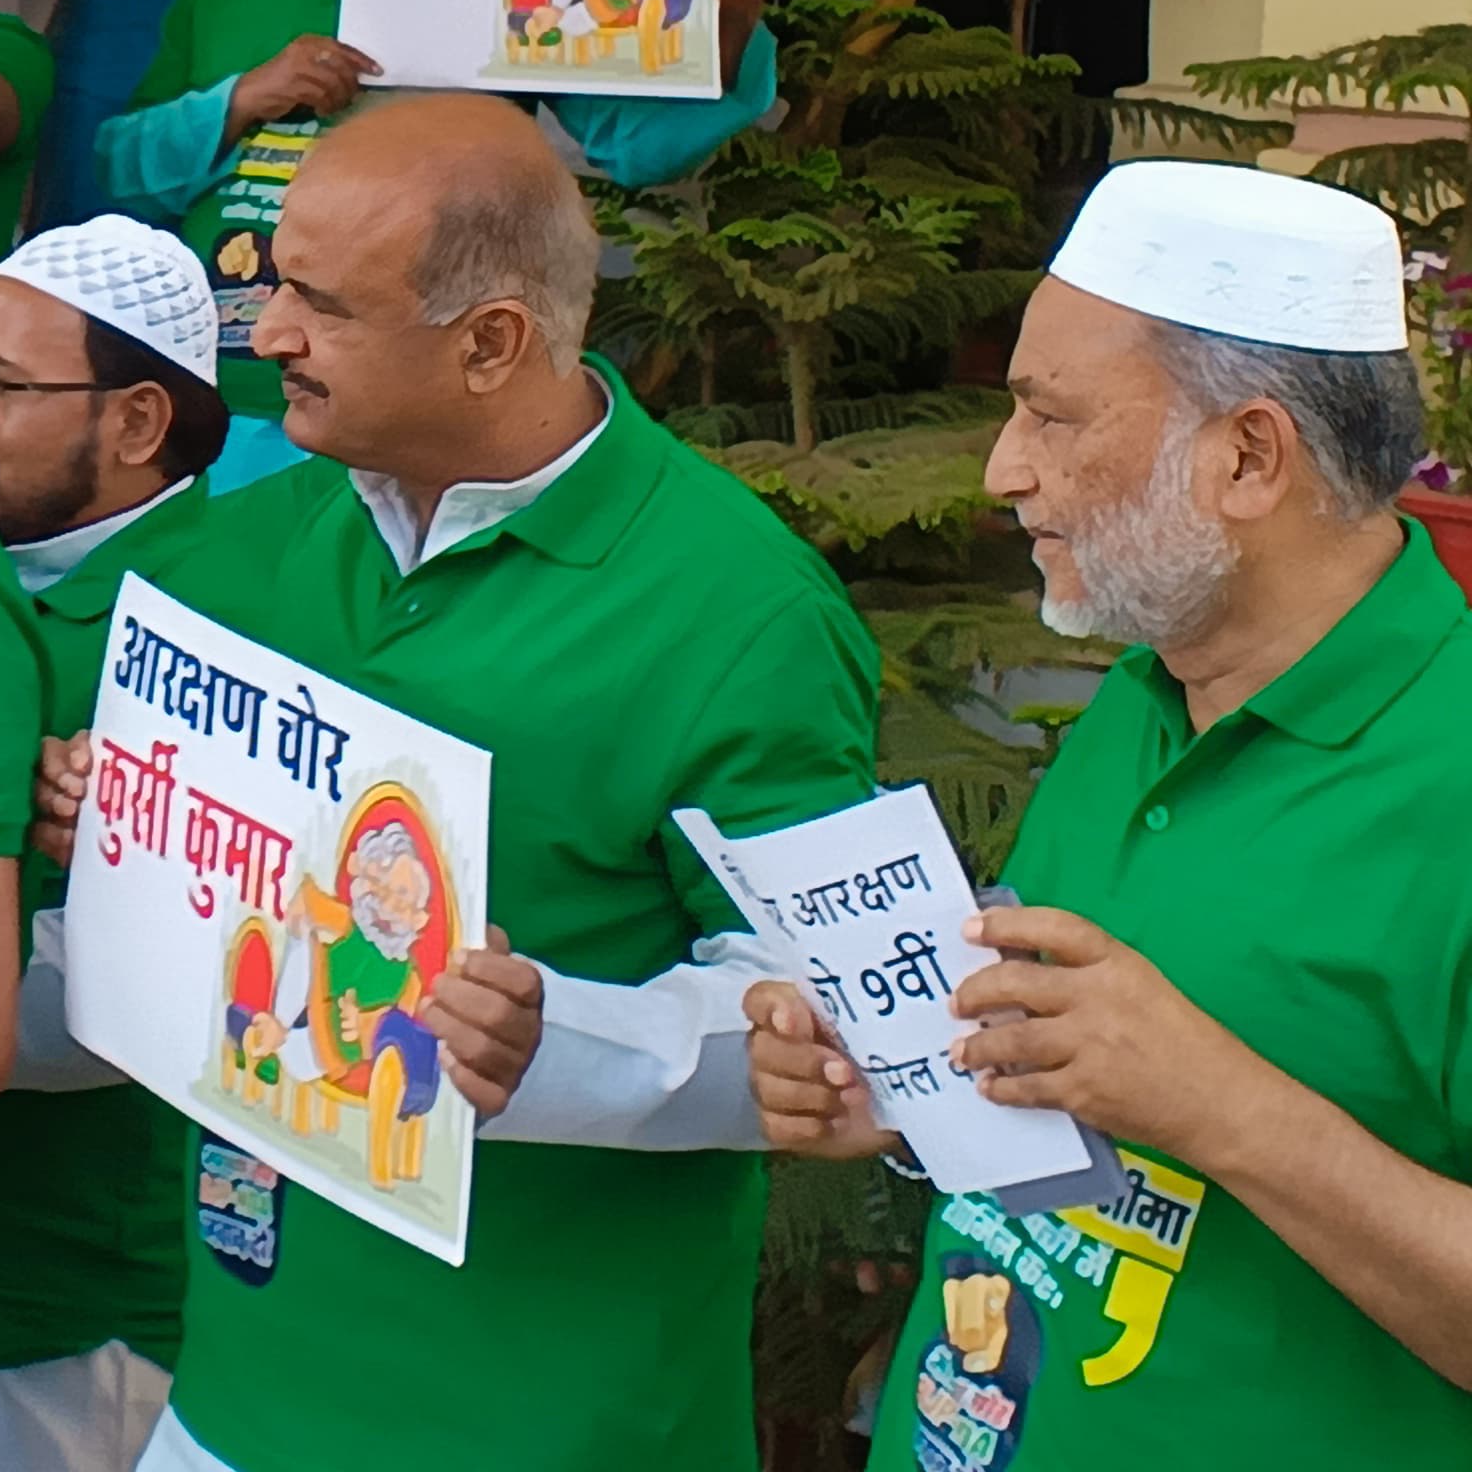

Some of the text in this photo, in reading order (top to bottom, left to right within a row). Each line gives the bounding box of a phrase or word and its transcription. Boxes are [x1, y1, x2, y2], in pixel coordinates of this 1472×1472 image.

[114, 616, 351, 801] आरक्षण चोर
[94, 738, 293, 923] कुर्सी कुमार
[791, 853, 932, 929] आरक्षण
[860, 930, 953, 1017] 9वीं
